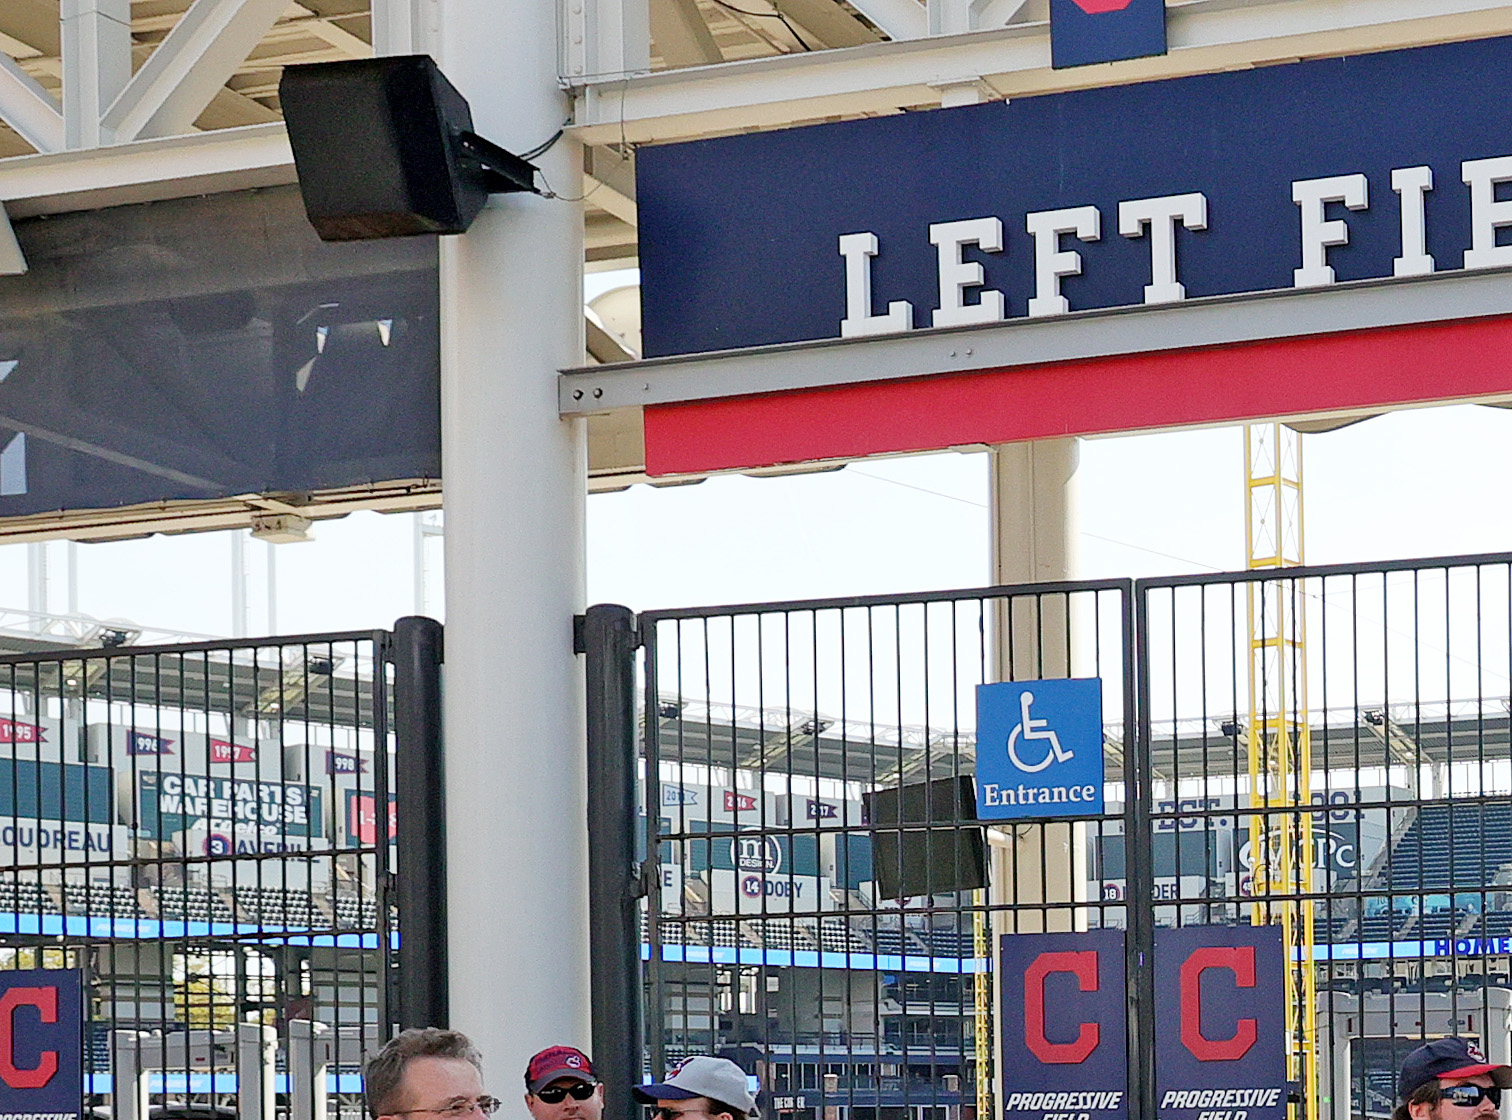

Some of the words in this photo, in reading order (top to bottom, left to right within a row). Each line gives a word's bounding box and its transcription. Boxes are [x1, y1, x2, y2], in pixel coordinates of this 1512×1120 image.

[838, 191, 1207, 338] LEFT
[2, 724, 31, 740] 195
[163, 775, 215, 798] CAR
[222, 780, 302, 805] PARTS
[984, 783, 1095, 806] Entrance
[160, 794, 308, 824] WAREHOUSE
[727, 794, 748, 809] 216
[809, 803, 829, 817] 217
[1158, 798, 1228, 830] EST.
[0, 826, 112, 852] OUDREAU
[210, 840, 224, 855] 3
[746, 881, 760, 894] 14
[1103, 888, 1118, 902] 18
[1434, 937, 1511, 957] HOME
[1024, 951, 1100, 1064] C
[1180, 946, 1258, 1062] C
[1006, 1091, 1123, 1112] PROGRESSIVE
[1161, 1088, 1282, 1109] PROGRESSIVE
